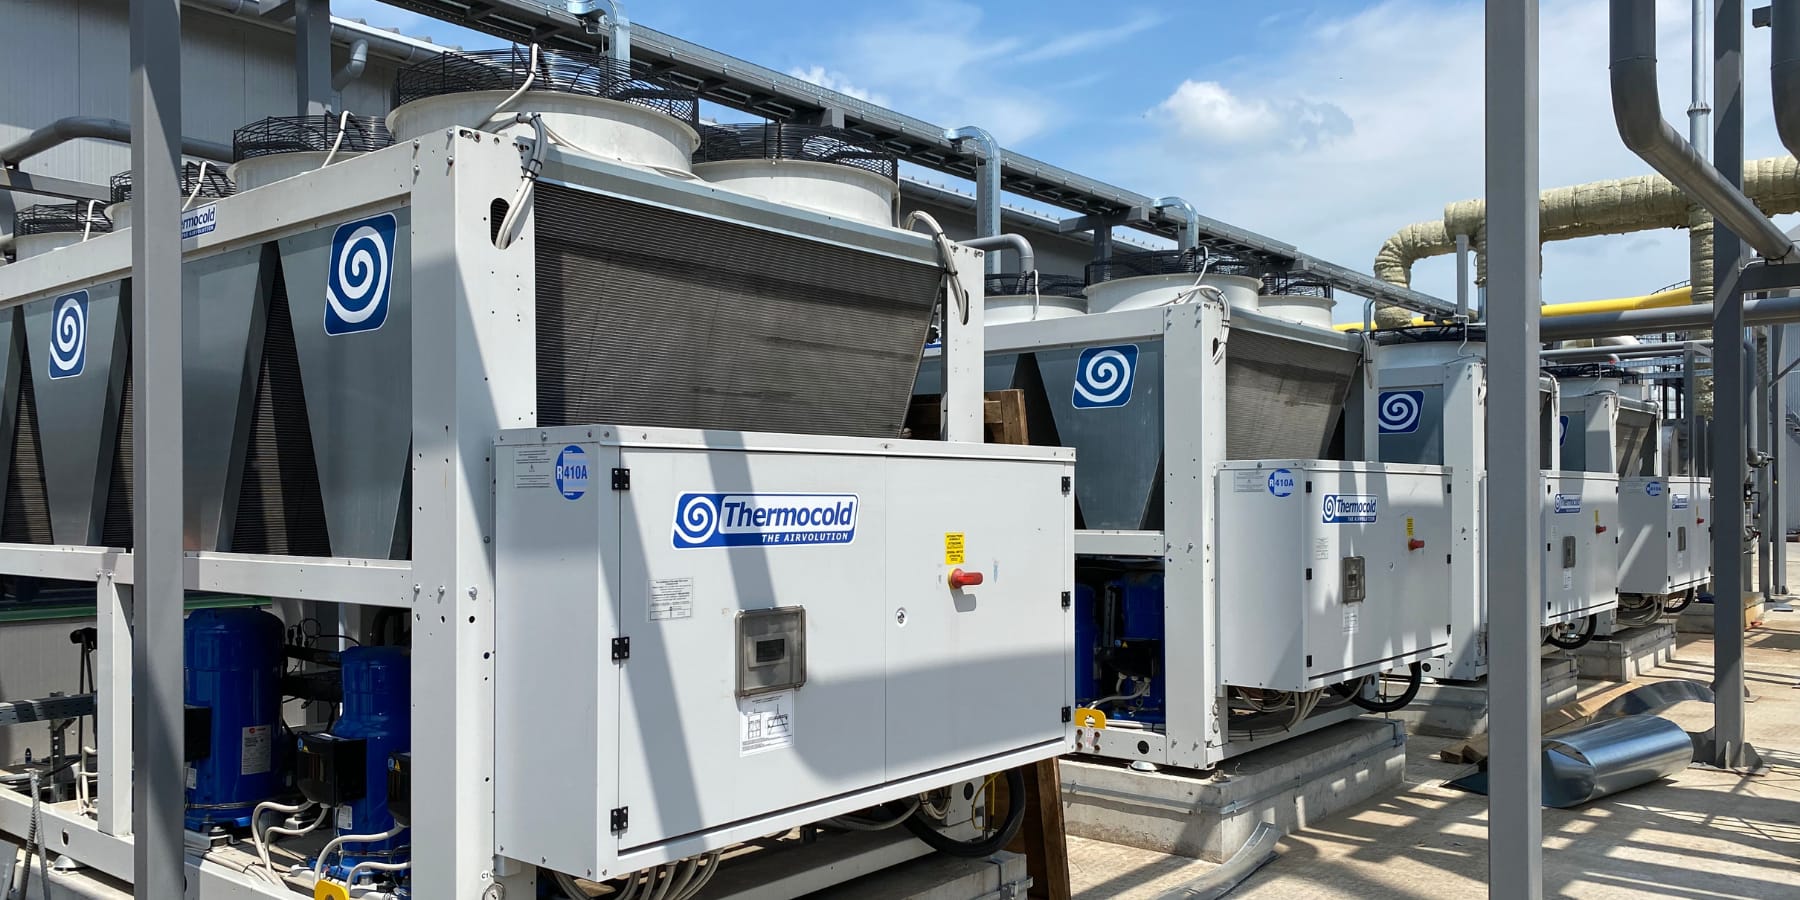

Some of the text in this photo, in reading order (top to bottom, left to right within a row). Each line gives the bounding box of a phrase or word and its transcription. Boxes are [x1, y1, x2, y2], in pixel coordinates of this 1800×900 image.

[182, 207, 215, 230] rmocold
[724, 502, 853, 527] Thermocold
[1337, 499, 1376, 512] Thermocold
[762, 532, 849, 543] THE AIRVOLUTION
